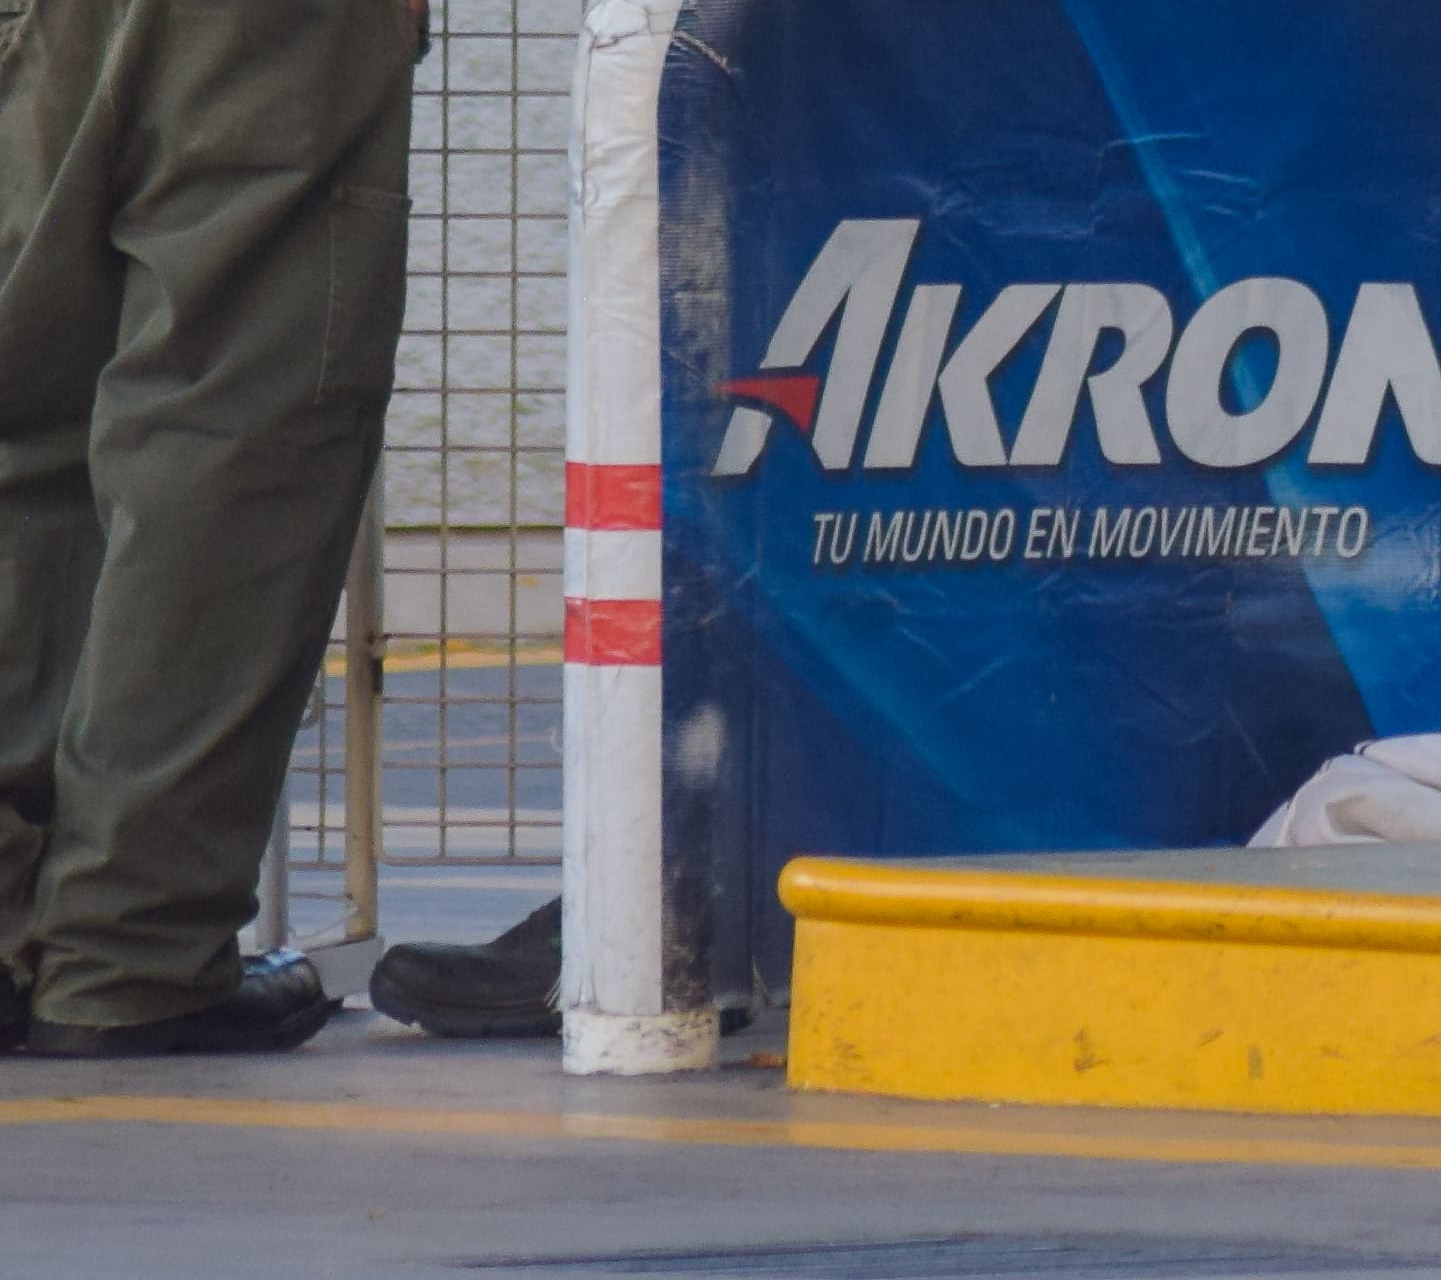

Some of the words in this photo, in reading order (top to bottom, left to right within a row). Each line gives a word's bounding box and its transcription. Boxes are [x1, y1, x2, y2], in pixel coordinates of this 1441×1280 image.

[813, 511, 851, 564] TU
[862, 508, 1015, 563] MUNDO
[1024, 507, 1074, 561] EN
[1087, 505, 1369, 561] MOVIMIENTO
